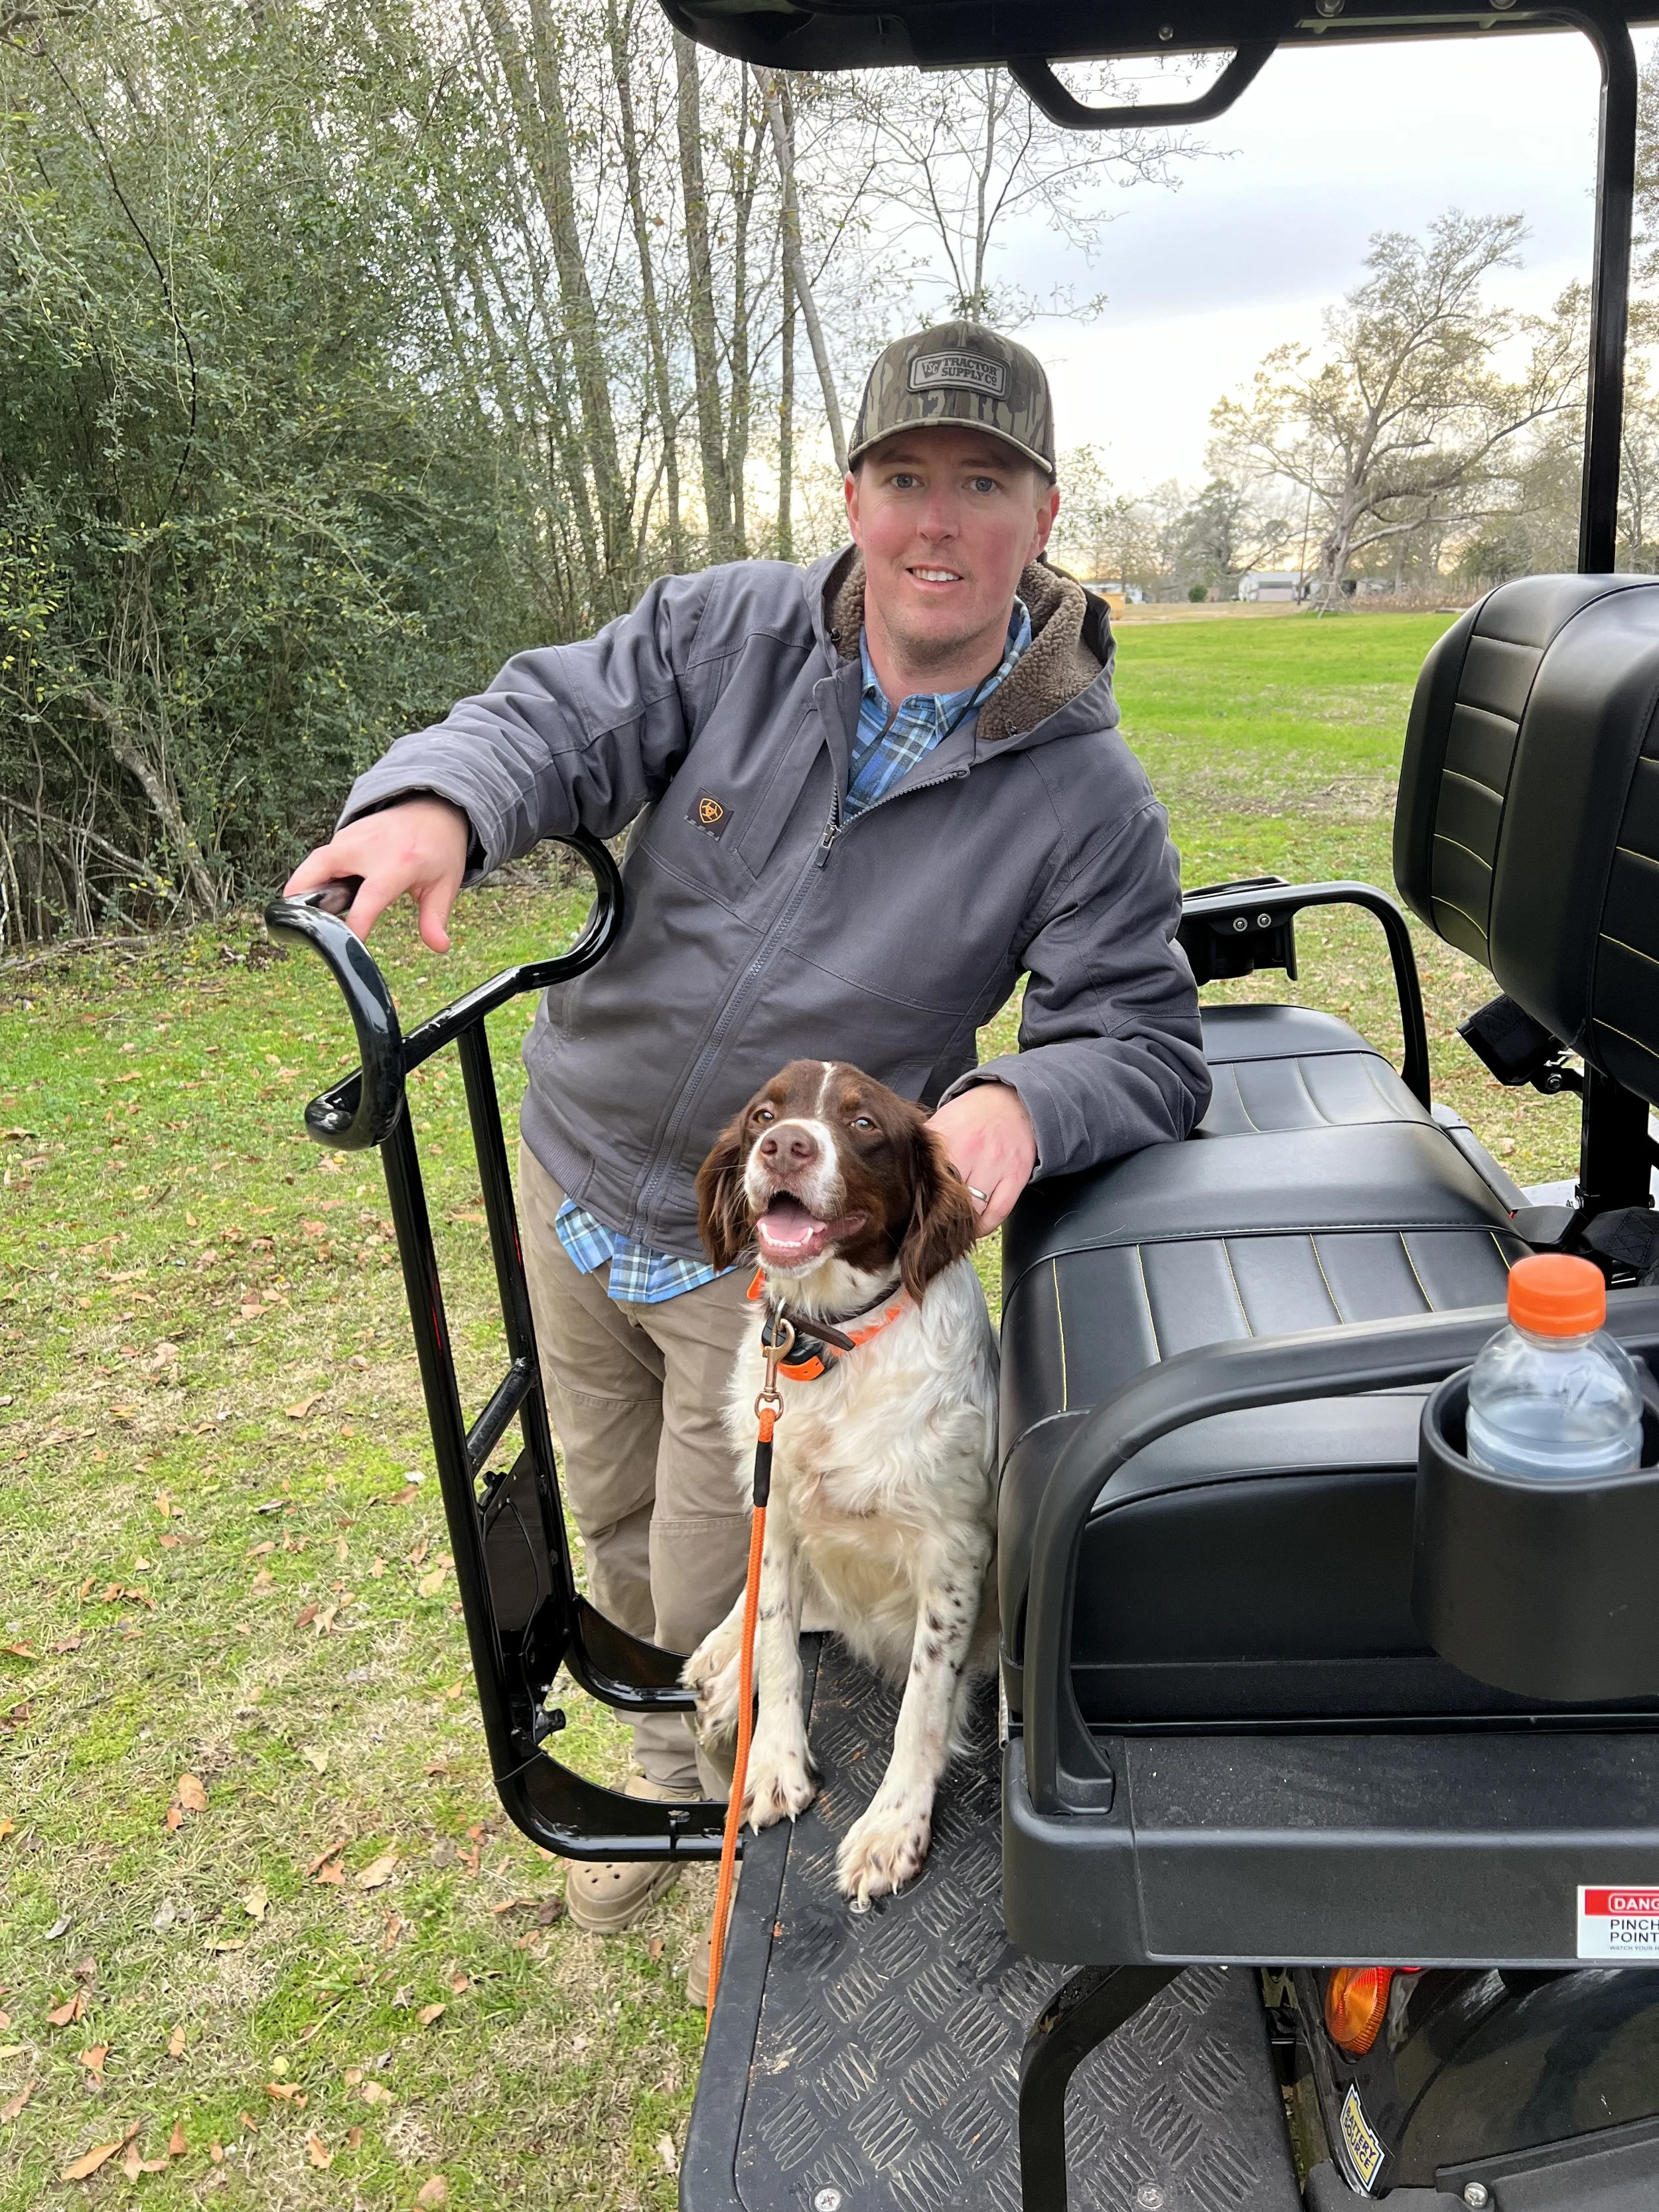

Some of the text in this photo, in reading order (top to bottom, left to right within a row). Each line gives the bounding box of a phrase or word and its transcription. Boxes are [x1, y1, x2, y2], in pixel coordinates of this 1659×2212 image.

[924, 363, 938, 374] TSC
[942, 357, 997, 376] TRACTOR
[941, 367, 984, 381] SUPPLY
[1611, 1919, 1659, 1931] PINCH
[1610, 1932, 1659, 1943] POINT
[1346, 2106, 1376, 2158] BATTERY
[1344, 2117, 1371, 2170] SOURCE
